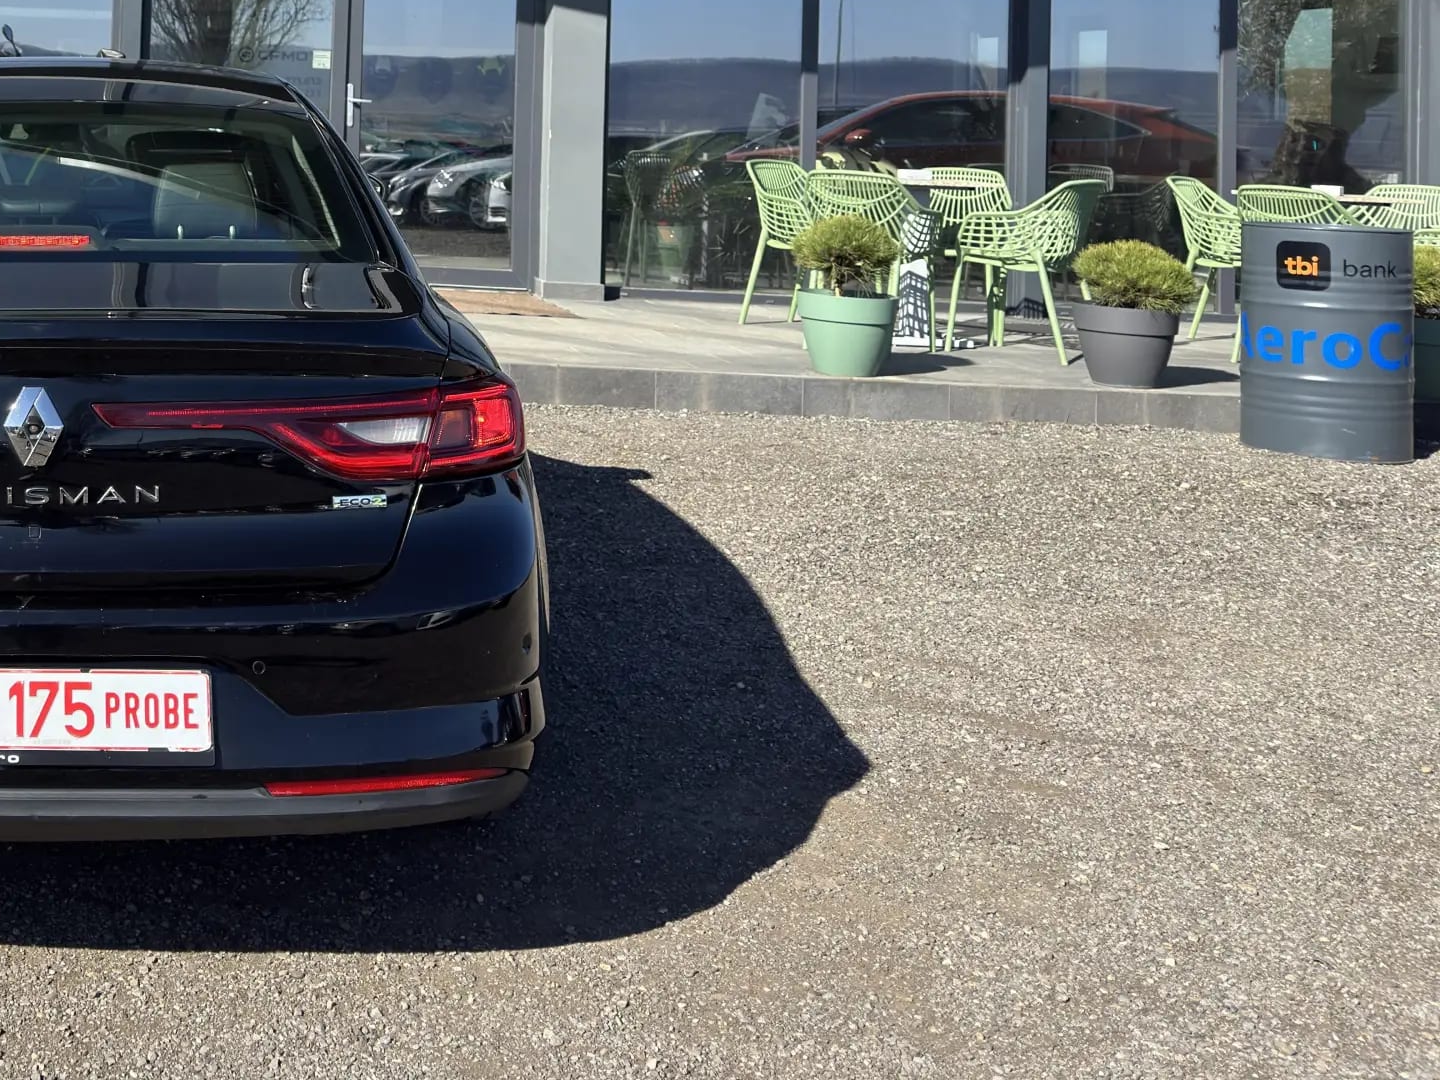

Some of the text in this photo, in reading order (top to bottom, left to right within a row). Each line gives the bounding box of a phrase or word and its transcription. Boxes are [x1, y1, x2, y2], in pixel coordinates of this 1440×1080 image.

[1283, 255, 1399, 278] tbi bank
[8, 680, 96, 738] 175
[105, 692, 200, 730] PROBE
